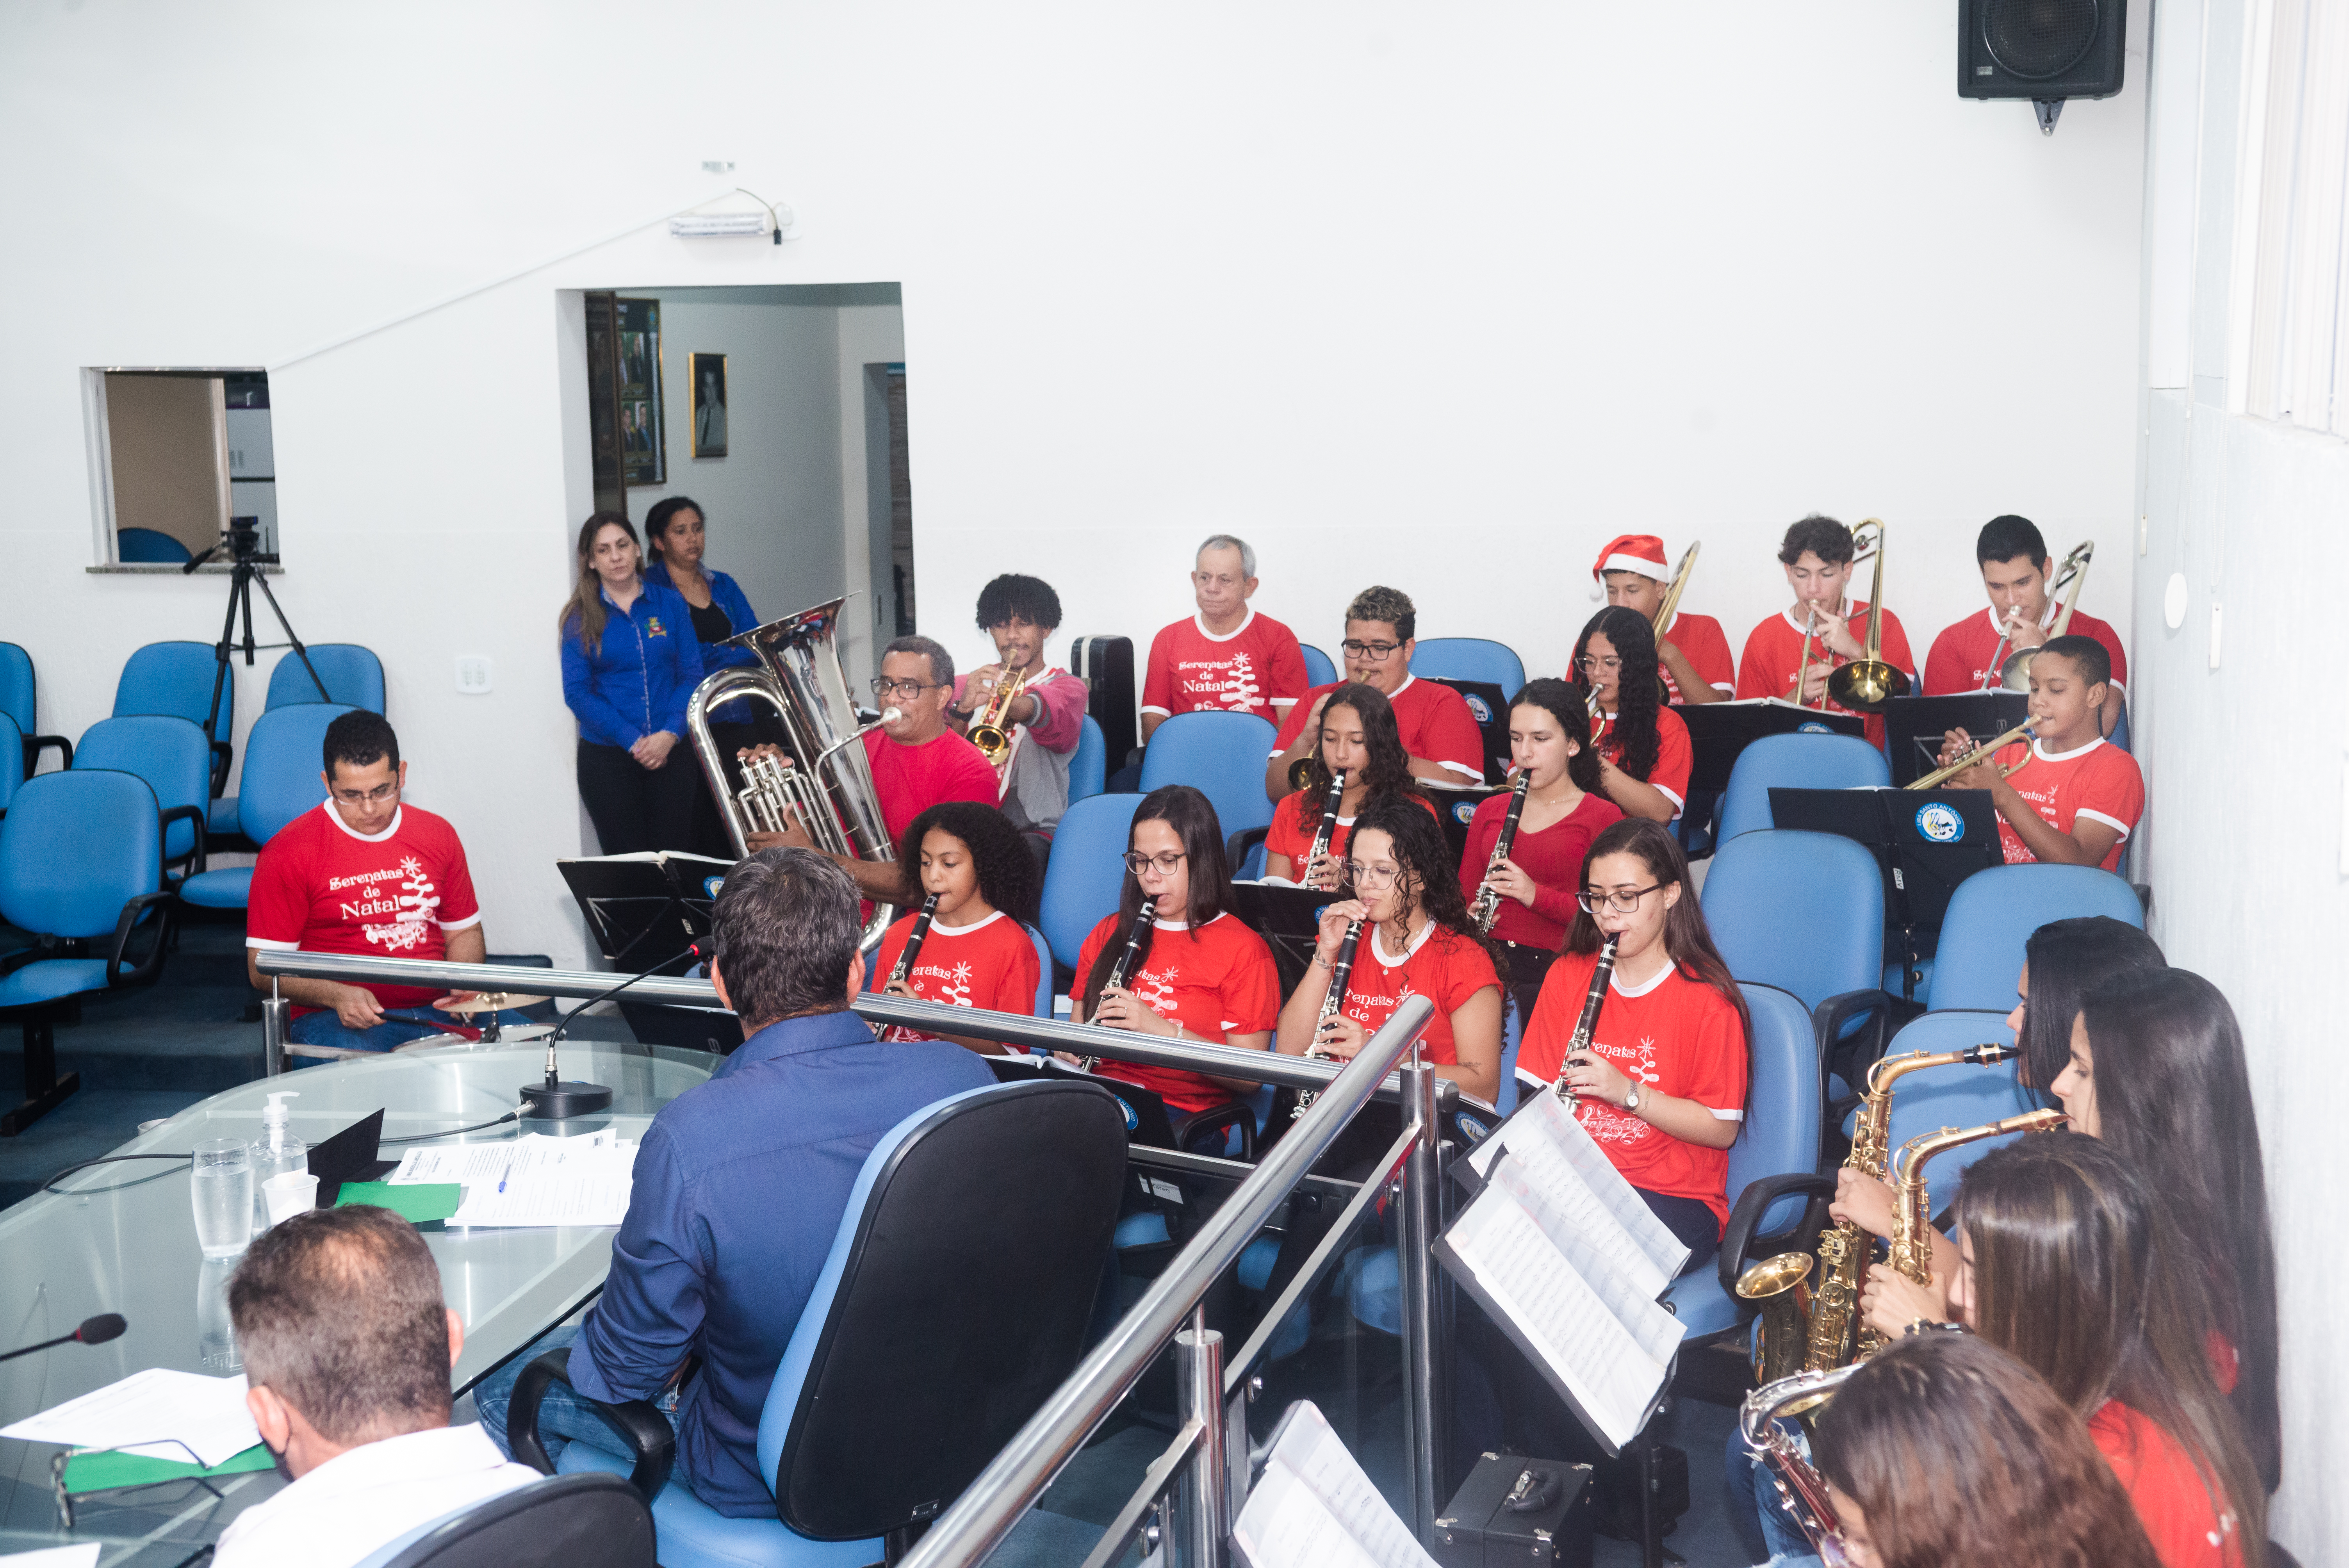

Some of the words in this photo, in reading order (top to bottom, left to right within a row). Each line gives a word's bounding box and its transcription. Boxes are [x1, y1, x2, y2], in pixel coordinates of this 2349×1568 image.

[1178, 661, 1233, 671] Serenatas
[1199, 671, 1214, 680] de
[1182, 680, 1226, 693] Natal
[1919, 804, 1938, 815] SANTO
[329, 869, 404, 891] Serenatas
[363, 886, 381, 898] de
[340, 894, 401, 920] Natal
[1345, 988, 1394, 1009] renatas
[1349, 1007, 1369, 1021] de
[1590, 1042, 1636, 1058] renatas
